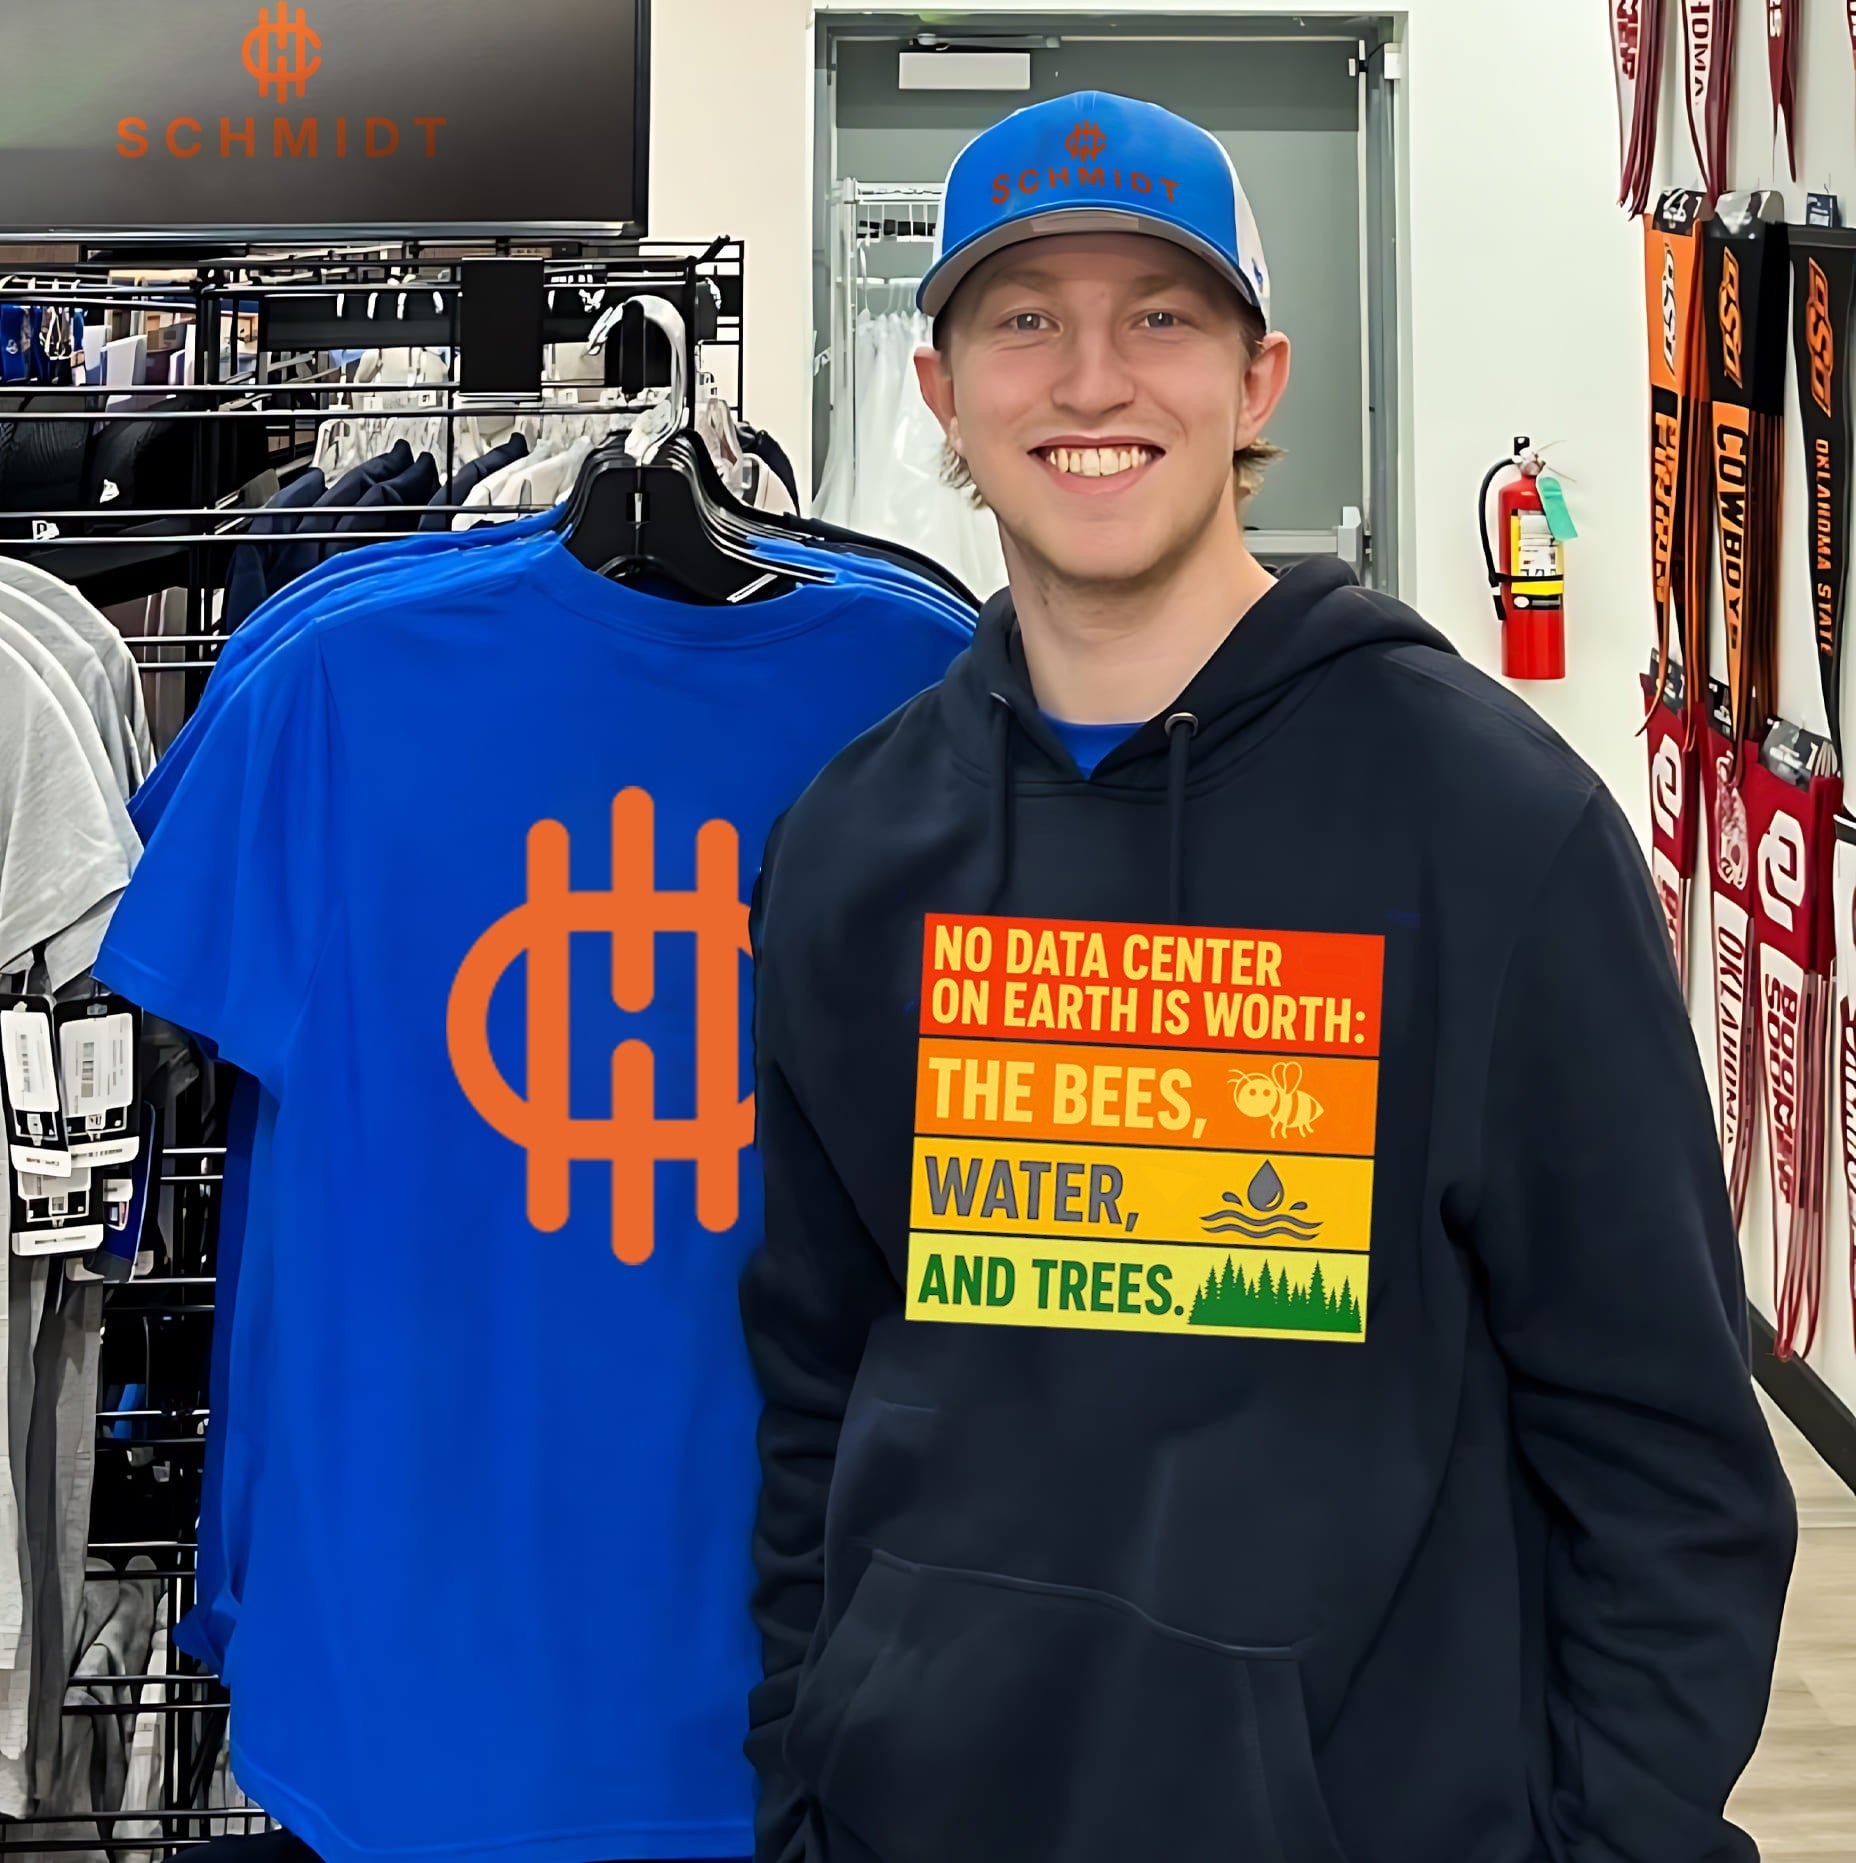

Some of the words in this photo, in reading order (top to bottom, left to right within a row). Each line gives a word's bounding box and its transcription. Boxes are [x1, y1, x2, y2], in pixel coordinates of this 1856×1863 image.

[115, 116, 448, 158] SCHMIDT
[991, 166, 1180, 205] SCHMIDT
[1815, 438, 1832, 570] OKLAHOMA
[933, 924, 993, 973] NO
[1006, 928, 1109, 980] DATA
[1122, 934, 1282, 988] CENTER
[931, 977, 990, 1026] ON
[1003, 980, 1137, 1033] EARTH
[1151, 988, 1190, 1037] IS
[1202, 990, 1367, 1044] WORTH:
[928, 1056, 1036, 1124] THE
[1052, 1062, 1208, 1140] BEES,
[924, 1155, 1139, 1233] WATER,
[917, 1252, 1016, 1308] AND
[1031, 1258, 1185, 1317] TREES.
